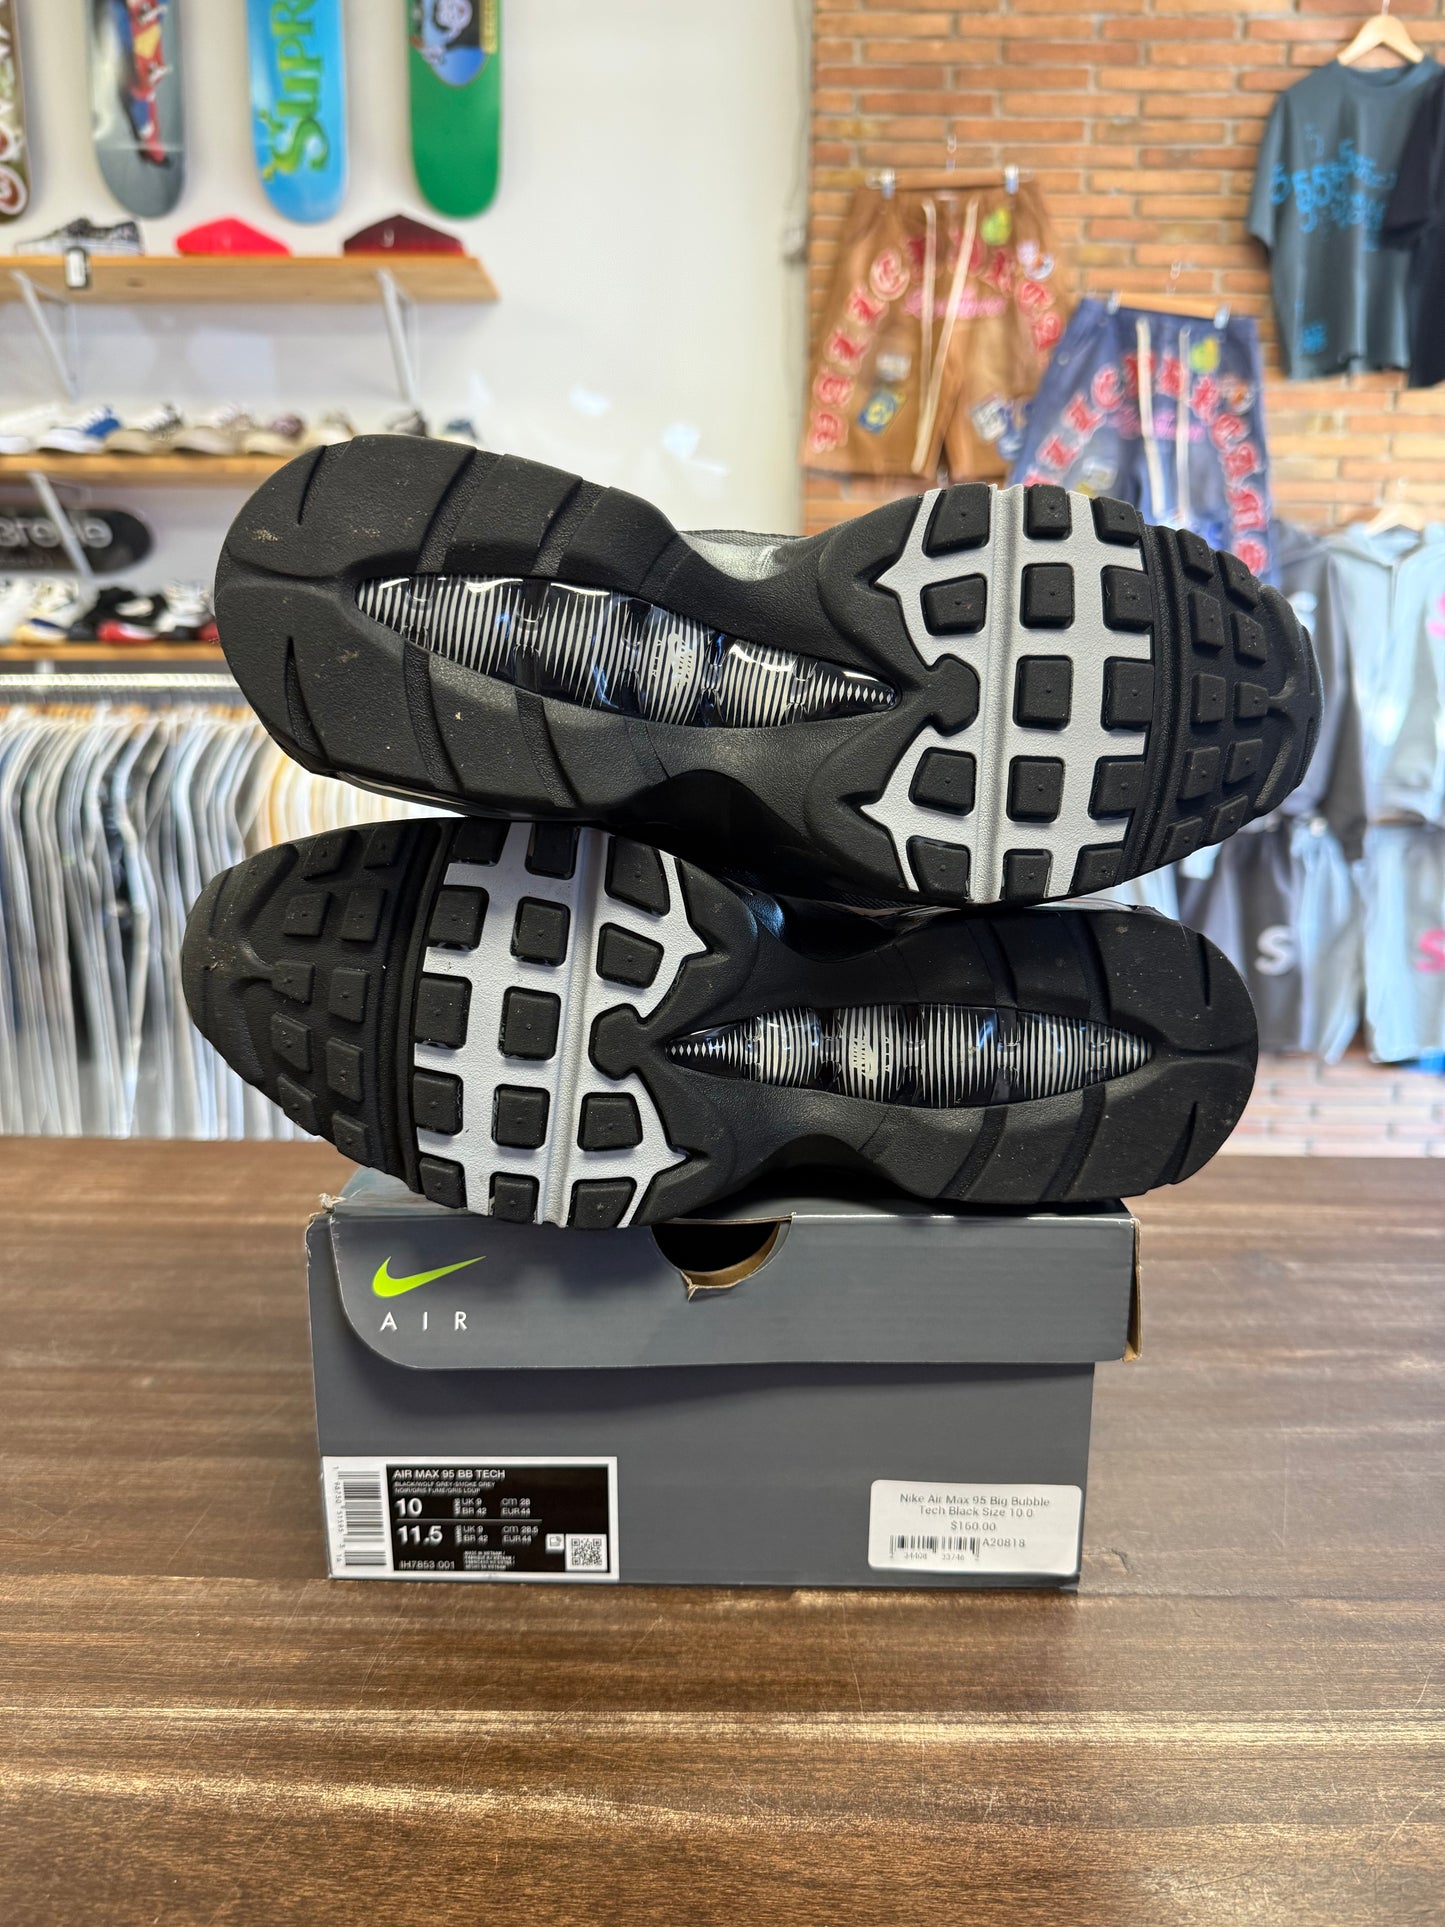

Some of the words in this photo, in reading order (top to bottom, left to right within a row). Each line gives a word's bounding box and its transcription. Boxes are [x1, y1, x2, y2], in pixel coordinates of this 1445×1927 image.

[1254, 924, 1298, 976] S
[380, 1310, 468, 1332] AIR
[393, 1469, 412, 1479] AIR
[414, 1469, 440, 1479] MAX
[442, 1469, 455, 1479] 95
[457, 1469, 473, 1479] BB
[475, 1469, 506, 1479] TECH
[461, 1498, 475, 1506] UK
[519, 1498, 531, 1506] 28
[900, 1493, 925, 1503] Nike
[927, 1494, 942, 1504] Air
[945, 1495, 969, 1504] Max
[972, 1495, 987, 1505] 95
[989, 1496, 1008, 1507] Big
[1011, 1496, 1050, 1507] Bubble
[395, 1497, 423, 1517] 10
[462, 1507, 475, 1516] BR
[476, 1507, 488, 1516] 42
[501, 1507, 520, 1516] EUR
[520, 1507, 531, 1516] 44
[919, 1505, 946, 1515] Tech
[948, 1506, 979, 1516] Black
[982, 1507, 1006, 1517] Size
[1010, 1508, 1033, 1518] 10.0
[463, 1525, 476, 1534] UK
[397, 1525, 443, 1545] 11.5
[463, 1534, 476, 1543] BR
[477, 1534, 489, 1543] 42
[502, 1534, 520, 1544] EUR
[520, 1534, 532, 1544] 44
[982, 1538, 1026, 1548] A20818
[437, 1560, 455, 1569] 001
